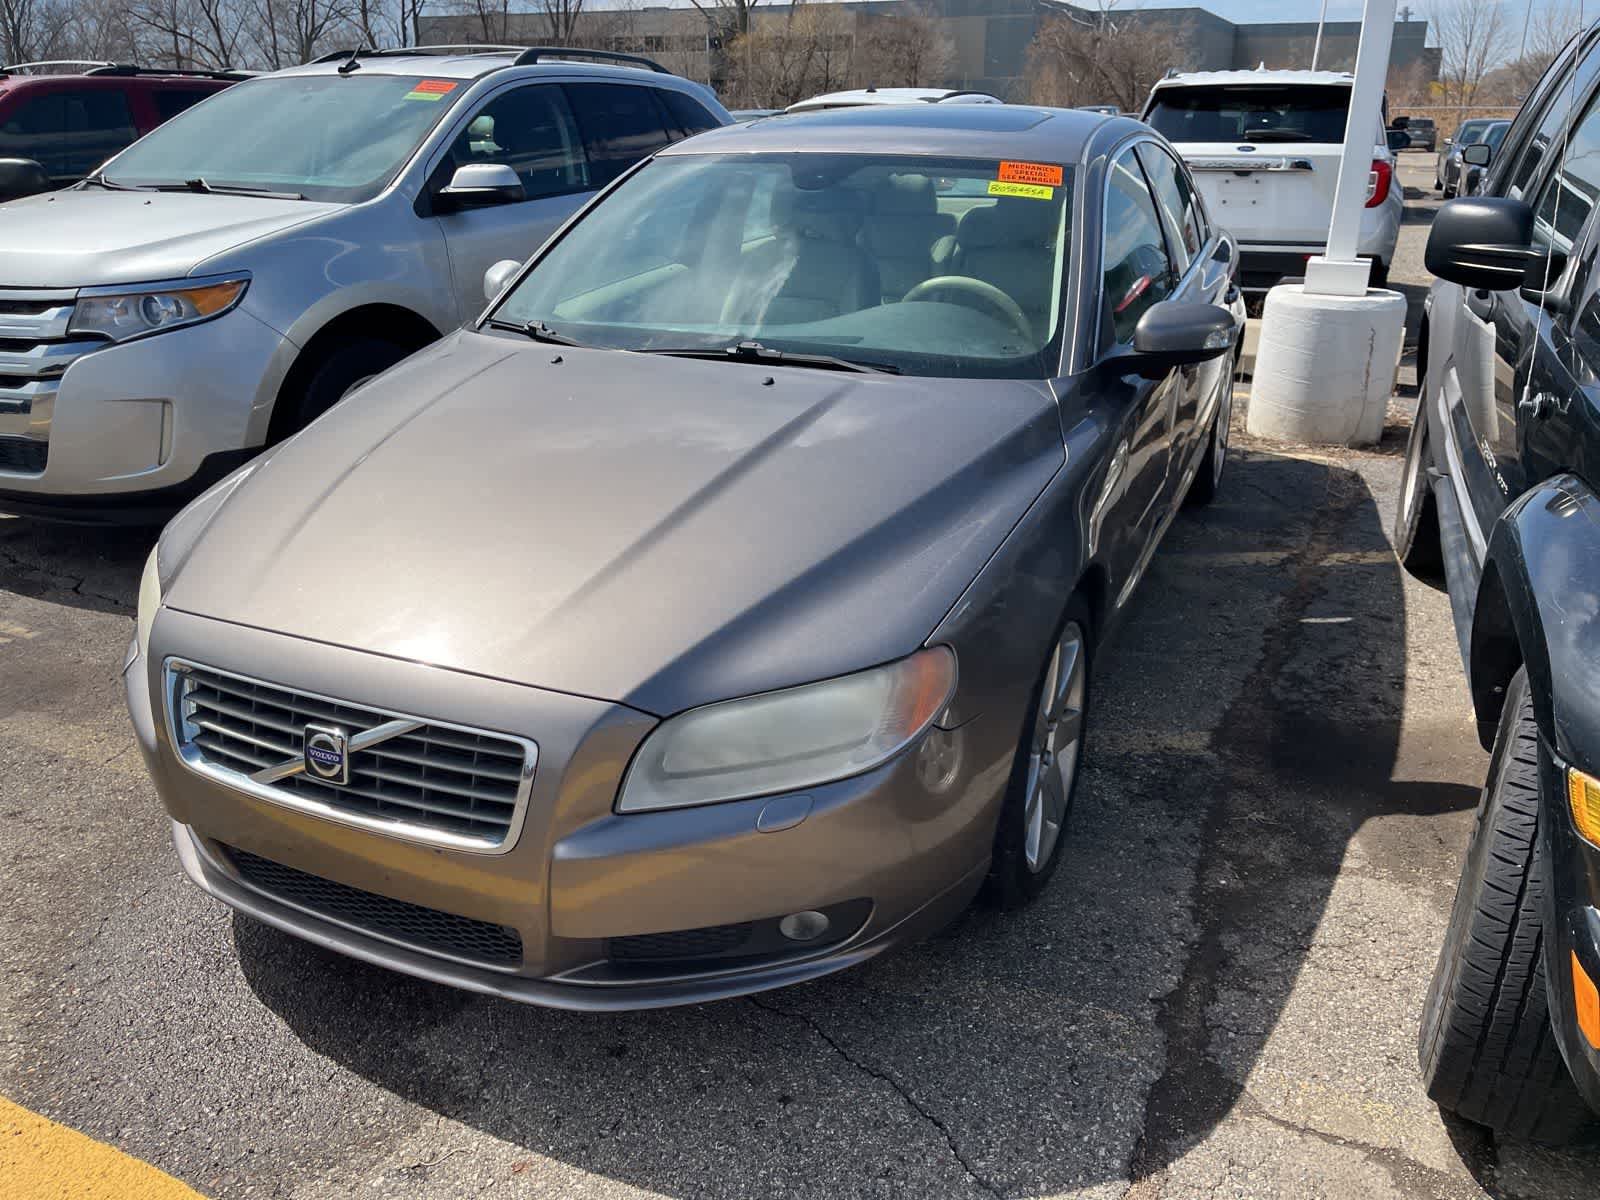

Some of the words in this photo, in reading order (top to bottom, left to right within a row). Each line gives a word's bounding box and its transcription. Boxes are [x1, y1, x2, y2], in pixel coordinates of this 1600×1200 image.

[1008, 164, 1055, 173] MECHANICS
[1014, 169, 1049, 177] SPECIAL
[1018, 175, 1059, 184] MANAGER
[309, 749, 340, 762] VOLVO
